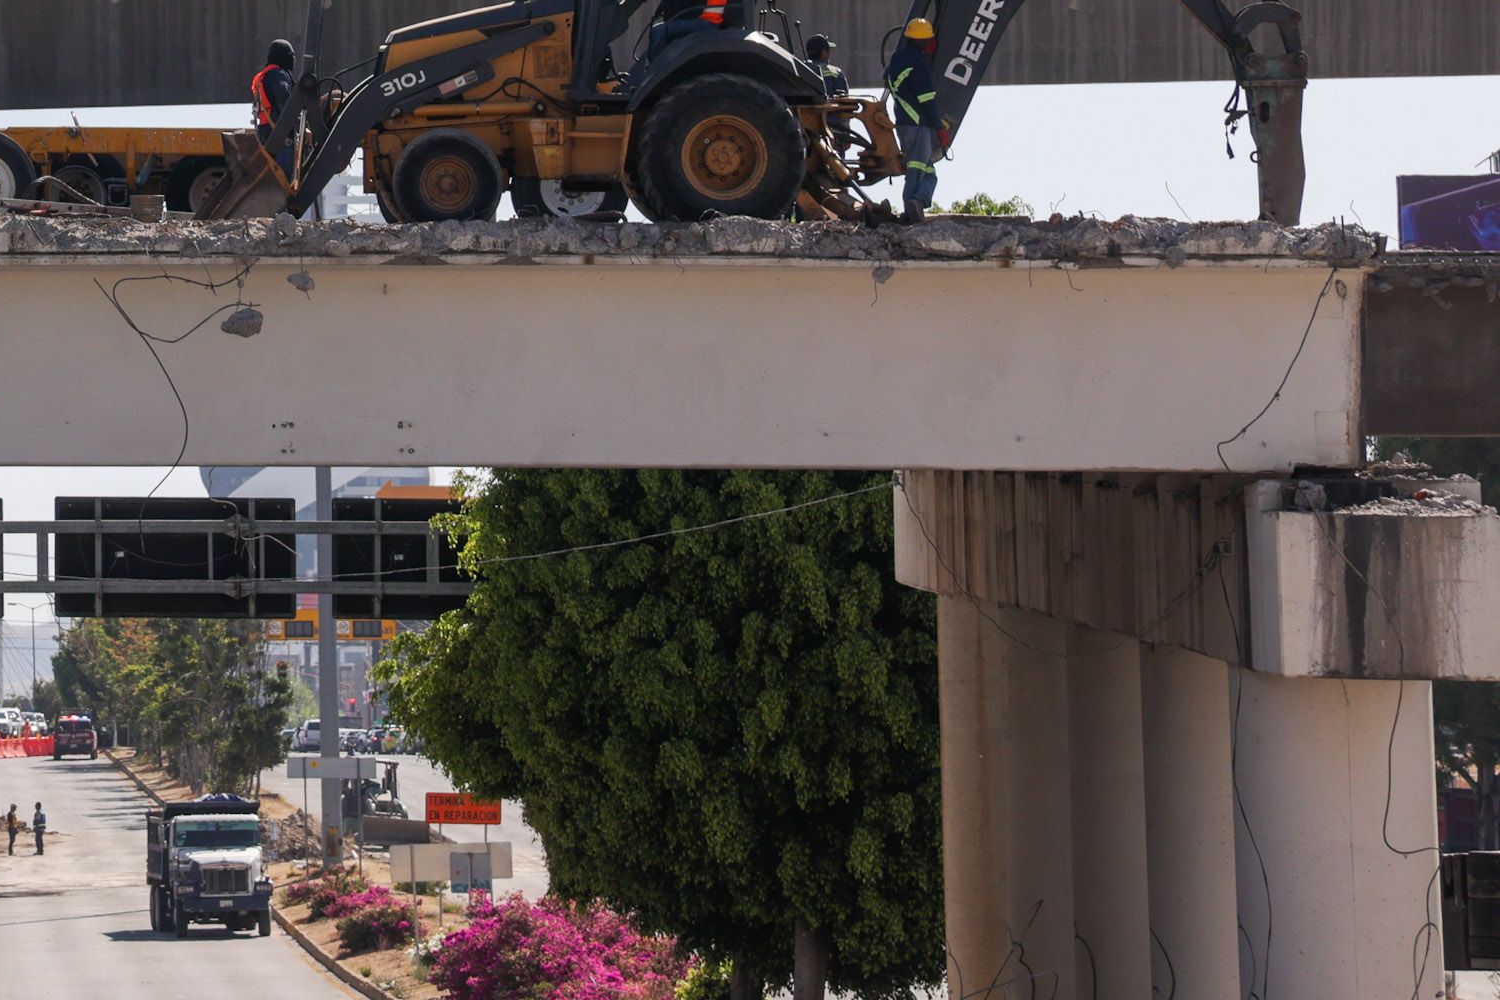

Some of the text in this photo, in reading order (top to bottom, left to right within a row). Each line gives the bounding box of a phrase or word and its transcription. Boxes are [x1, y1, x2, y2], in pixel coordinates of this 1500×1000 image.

[380, 70, 426, 96] 310J
[429, 810, 498, 820] EN REPARACION
